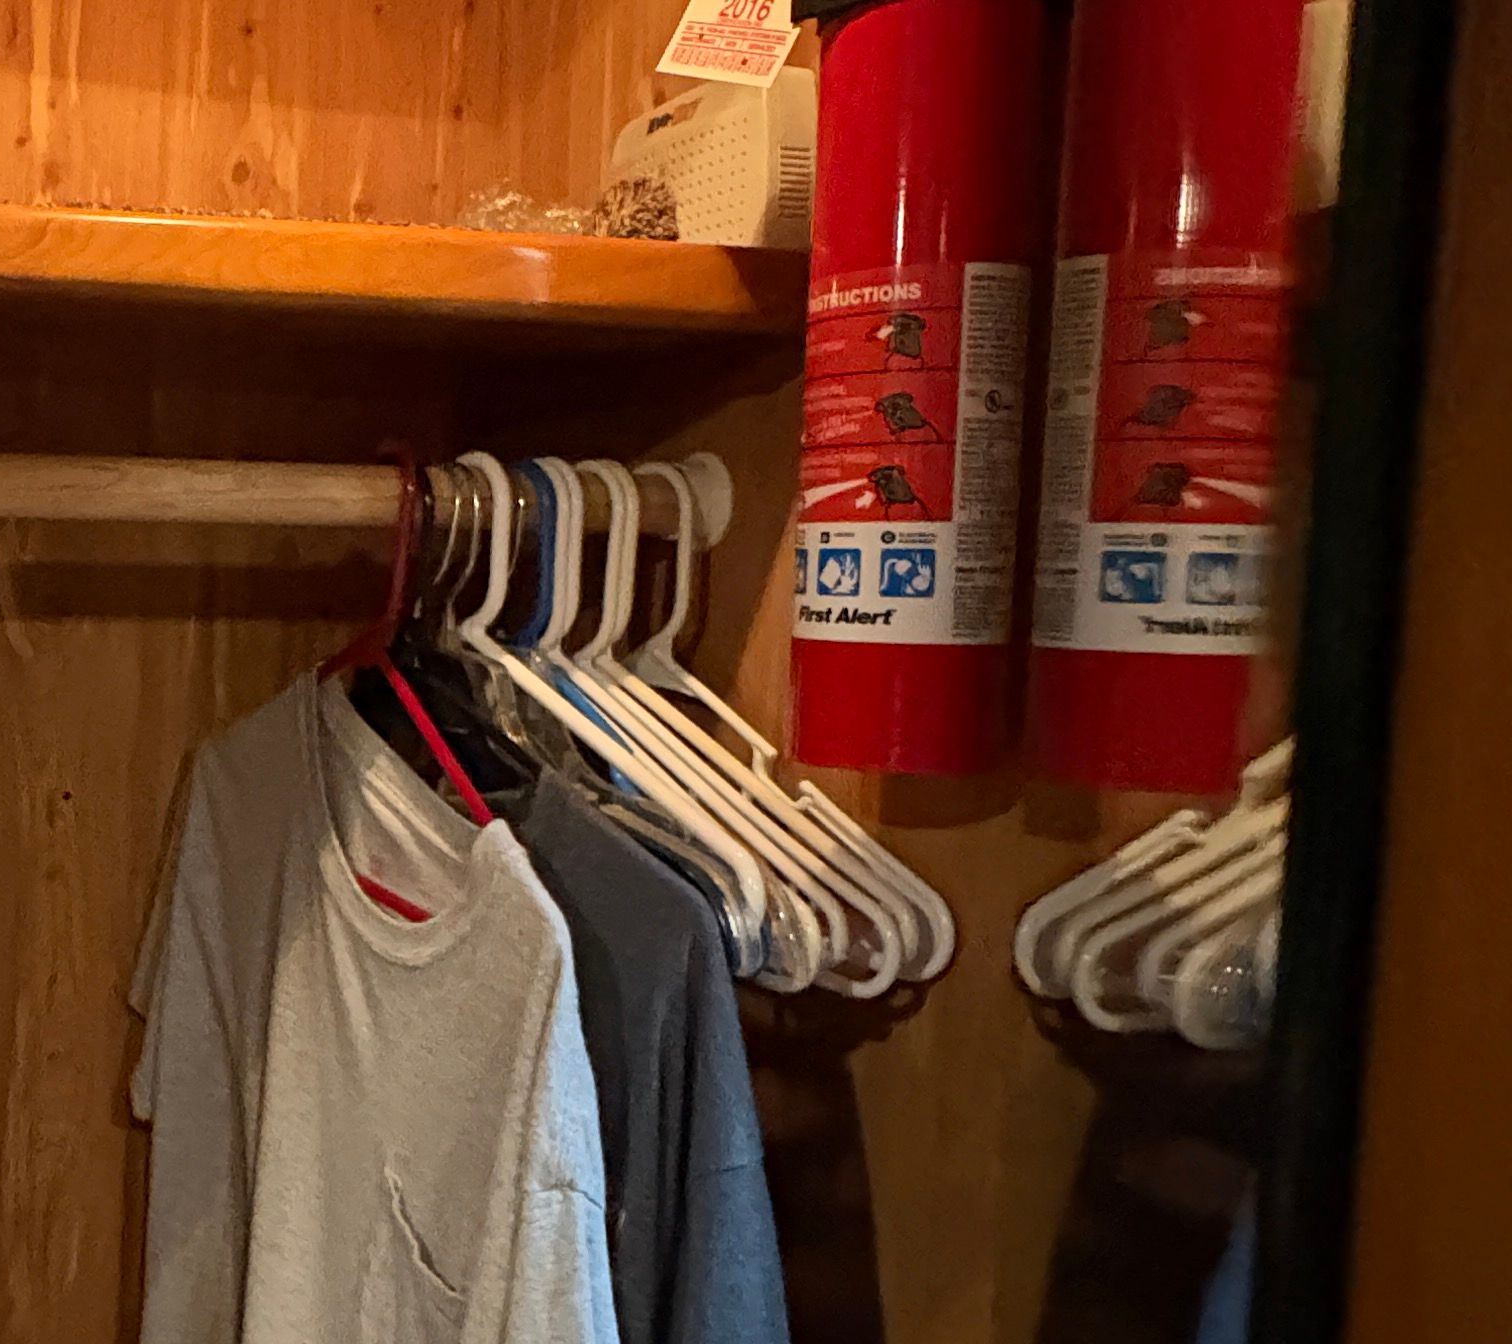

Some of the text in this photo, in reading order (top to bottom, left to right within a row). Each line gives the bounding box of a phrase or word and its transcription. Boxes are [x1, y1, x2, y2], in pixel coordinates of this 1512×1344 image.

[809, 282, 922, 312] STRUCTIONS
[799, 605, 892, 624] First Alert
